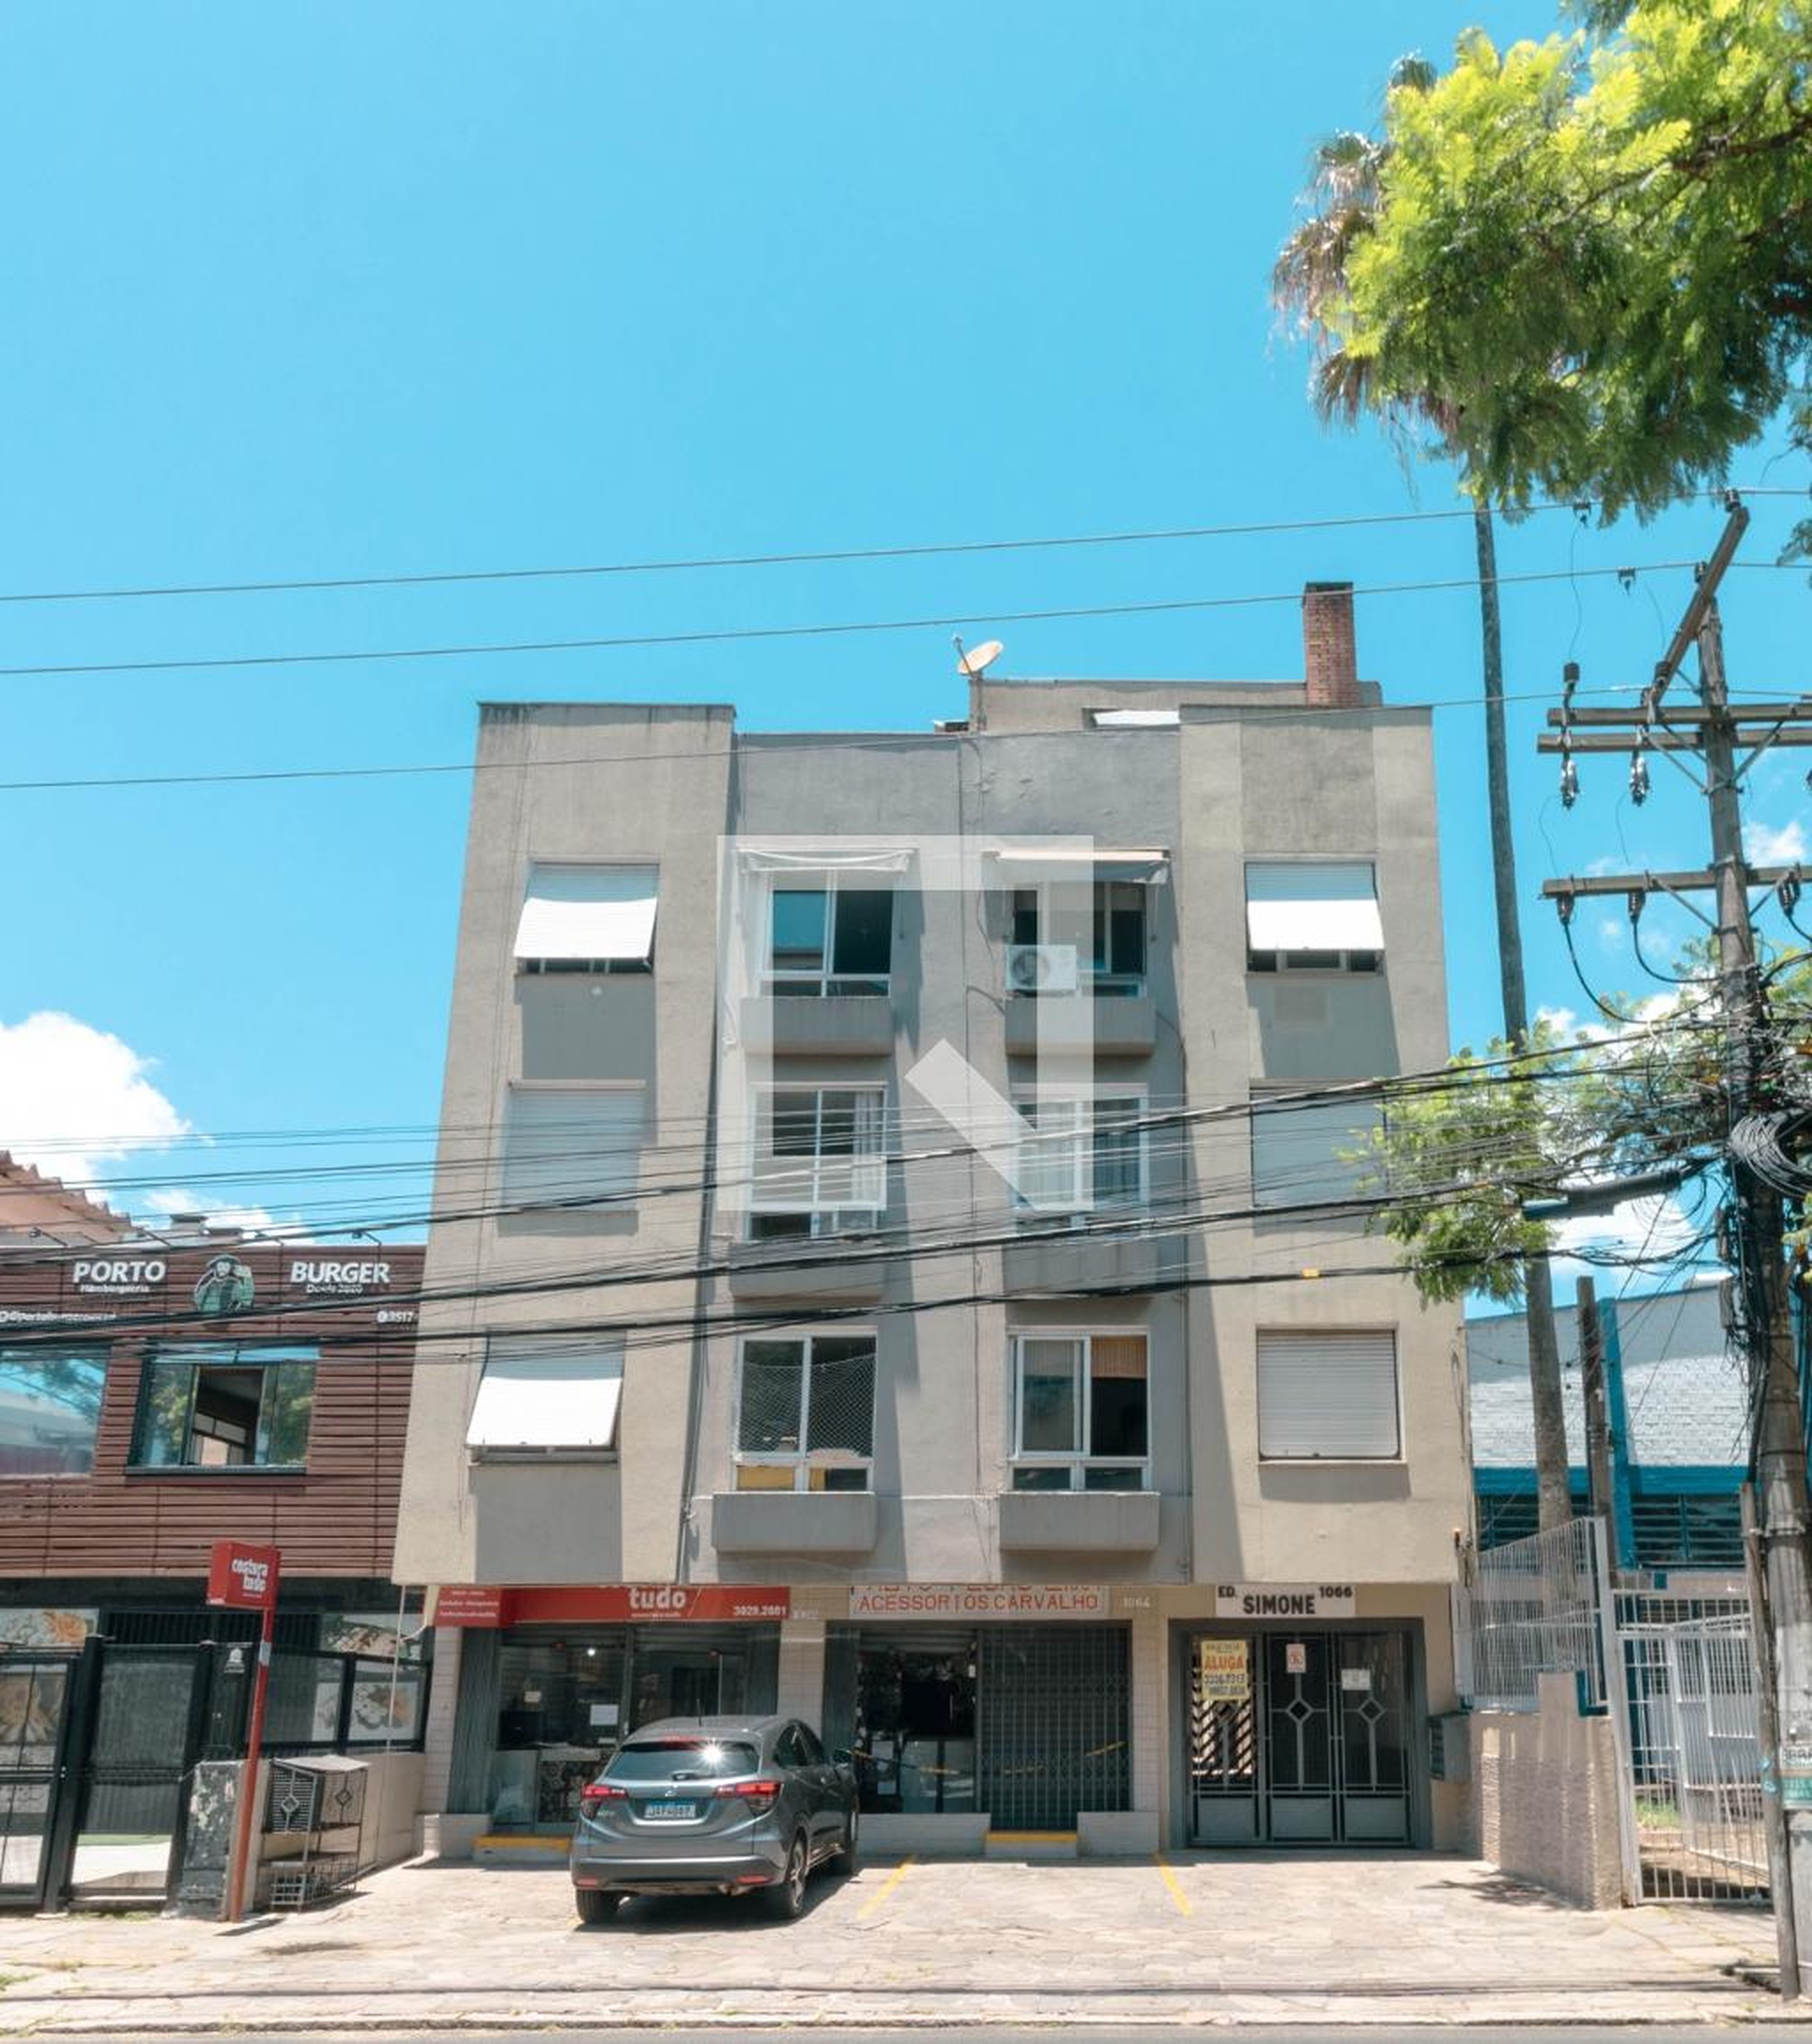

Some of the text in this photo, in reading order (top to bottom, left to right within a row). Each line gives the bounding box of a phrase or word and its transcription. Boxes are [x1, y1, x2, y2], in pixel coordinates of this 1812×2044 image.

[73, 1261, 166, 1283] PORTO
[290, 1262, 390, 1283] BURGER
[629, 1586, 686, 1608] tudo
[994, 1594, 1098, 1610] CARVALHO
[1243, 1594, 1315, 1615] SIMONE
[1319, 1586, 1353, 1598] 1066
[1204, 1655, 1244, 1670] ALUGA
